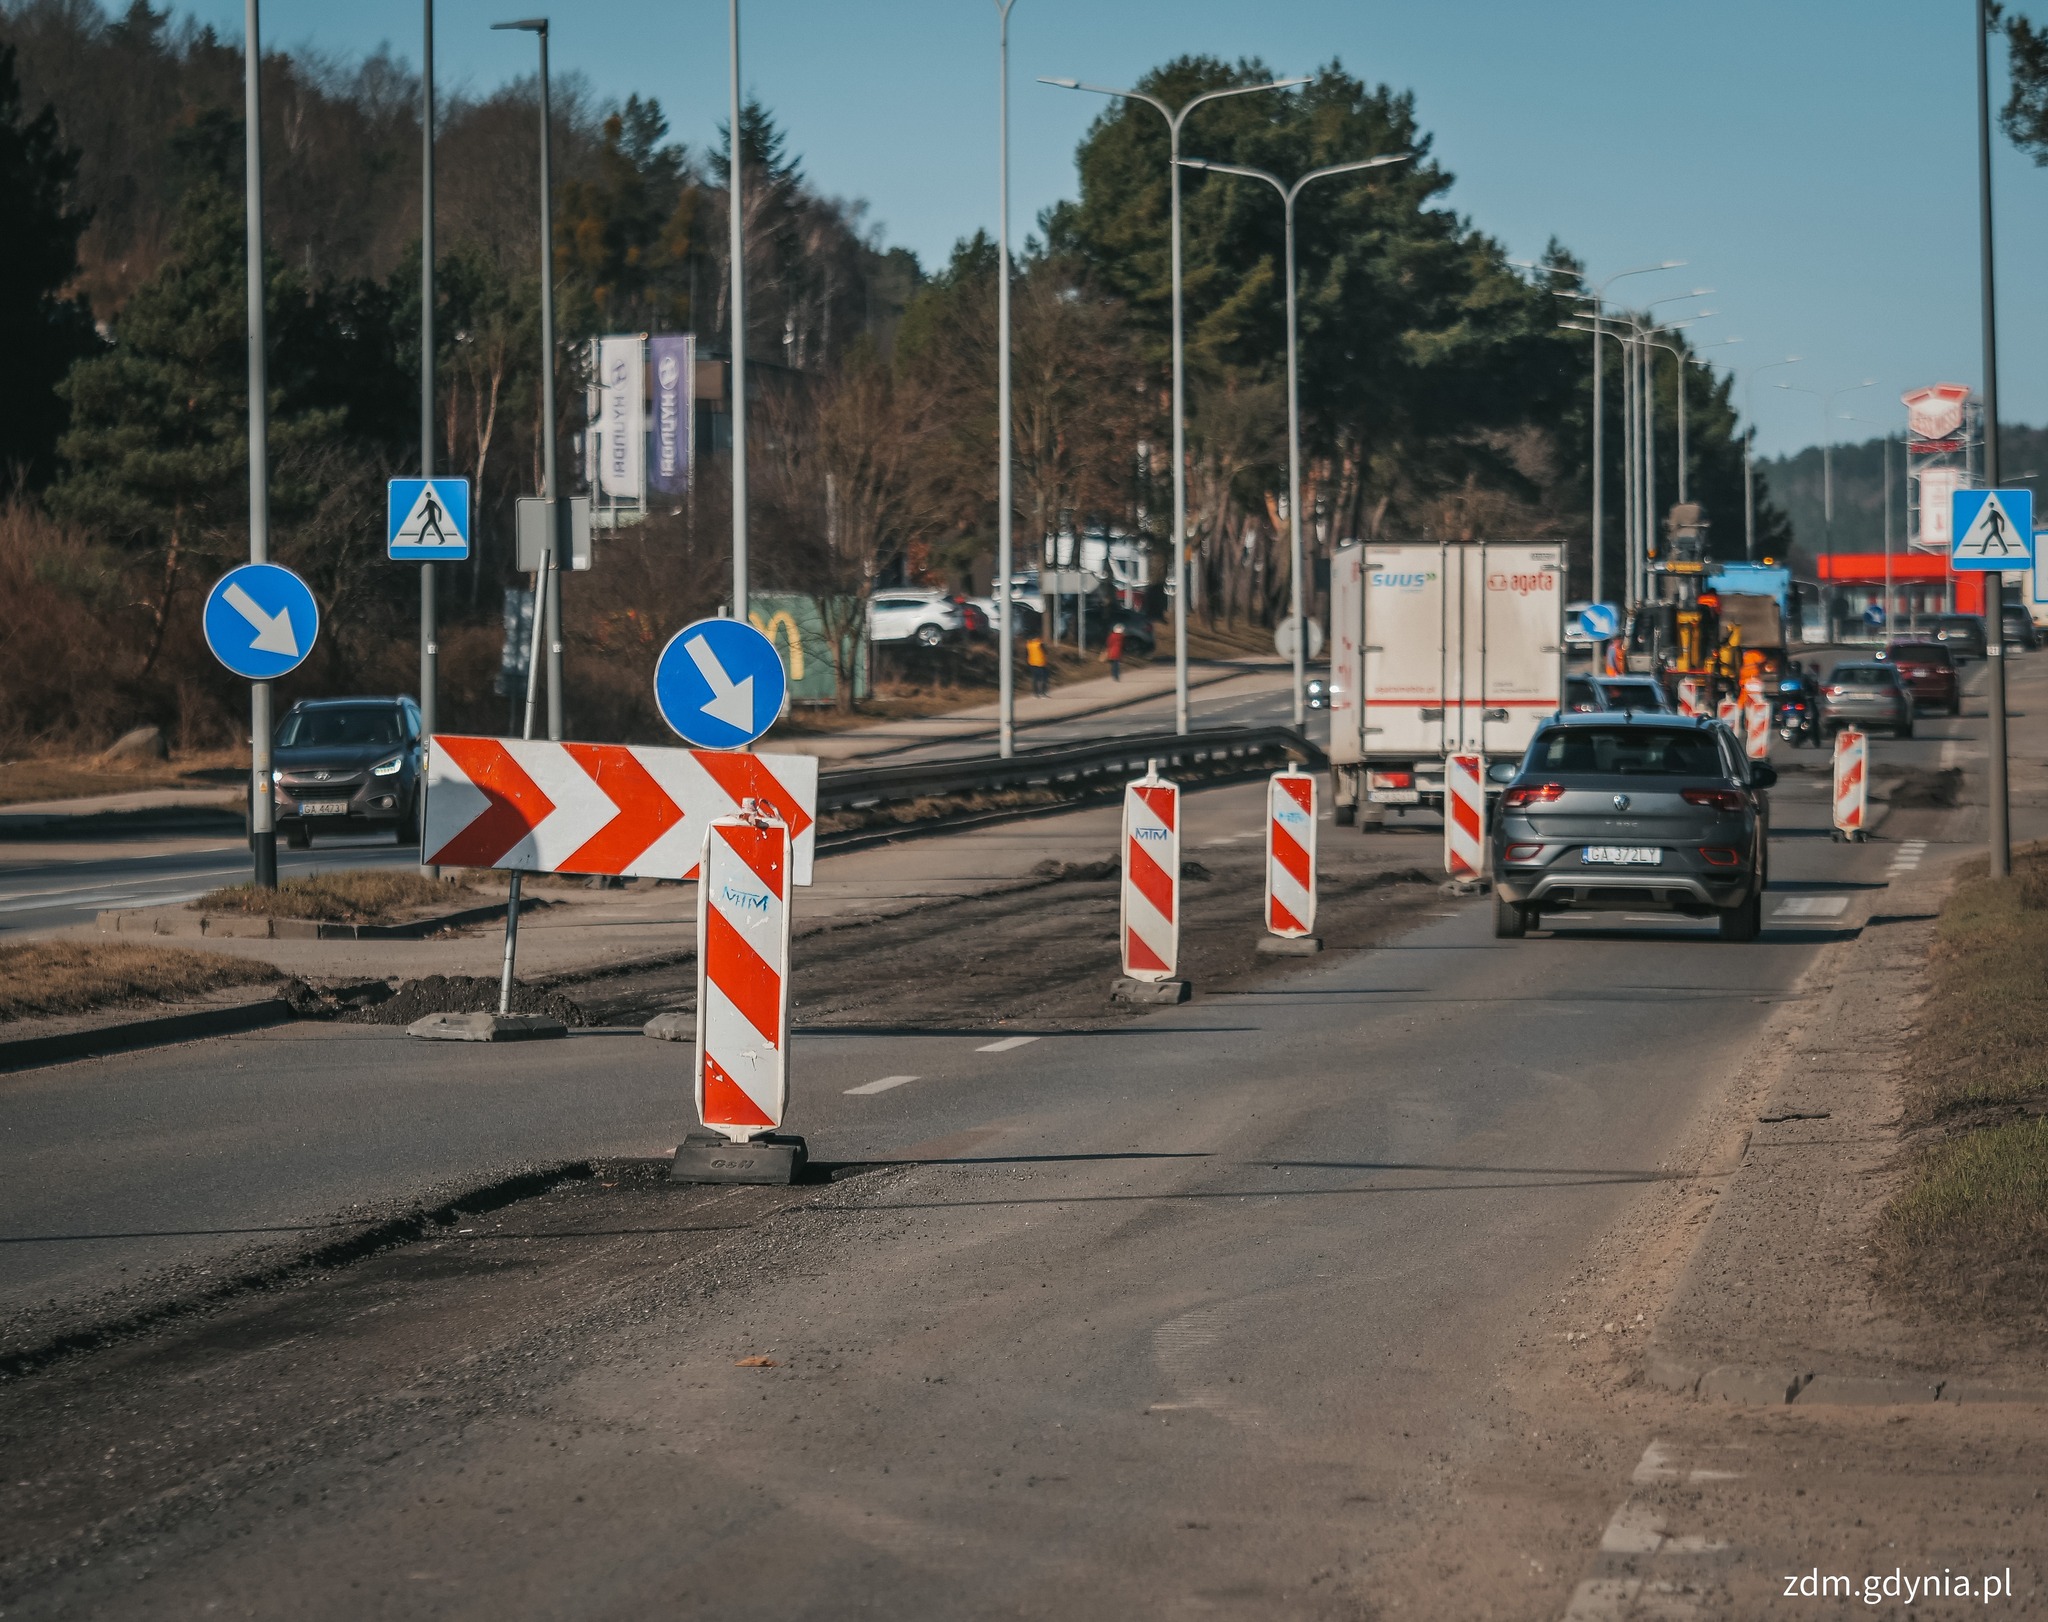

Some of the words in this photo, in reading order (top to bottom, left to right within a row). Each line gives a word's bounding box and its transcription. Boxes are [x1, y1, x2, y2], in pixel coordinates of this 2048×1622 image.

[1510, 572, 1554, 596] agata
[305, 805, 316, 814] GA
[1135, 827, 1167, 840] MTM
[1592, 848, 1608, 861] GA
[1615, 848, 1656, 861] 372LY
